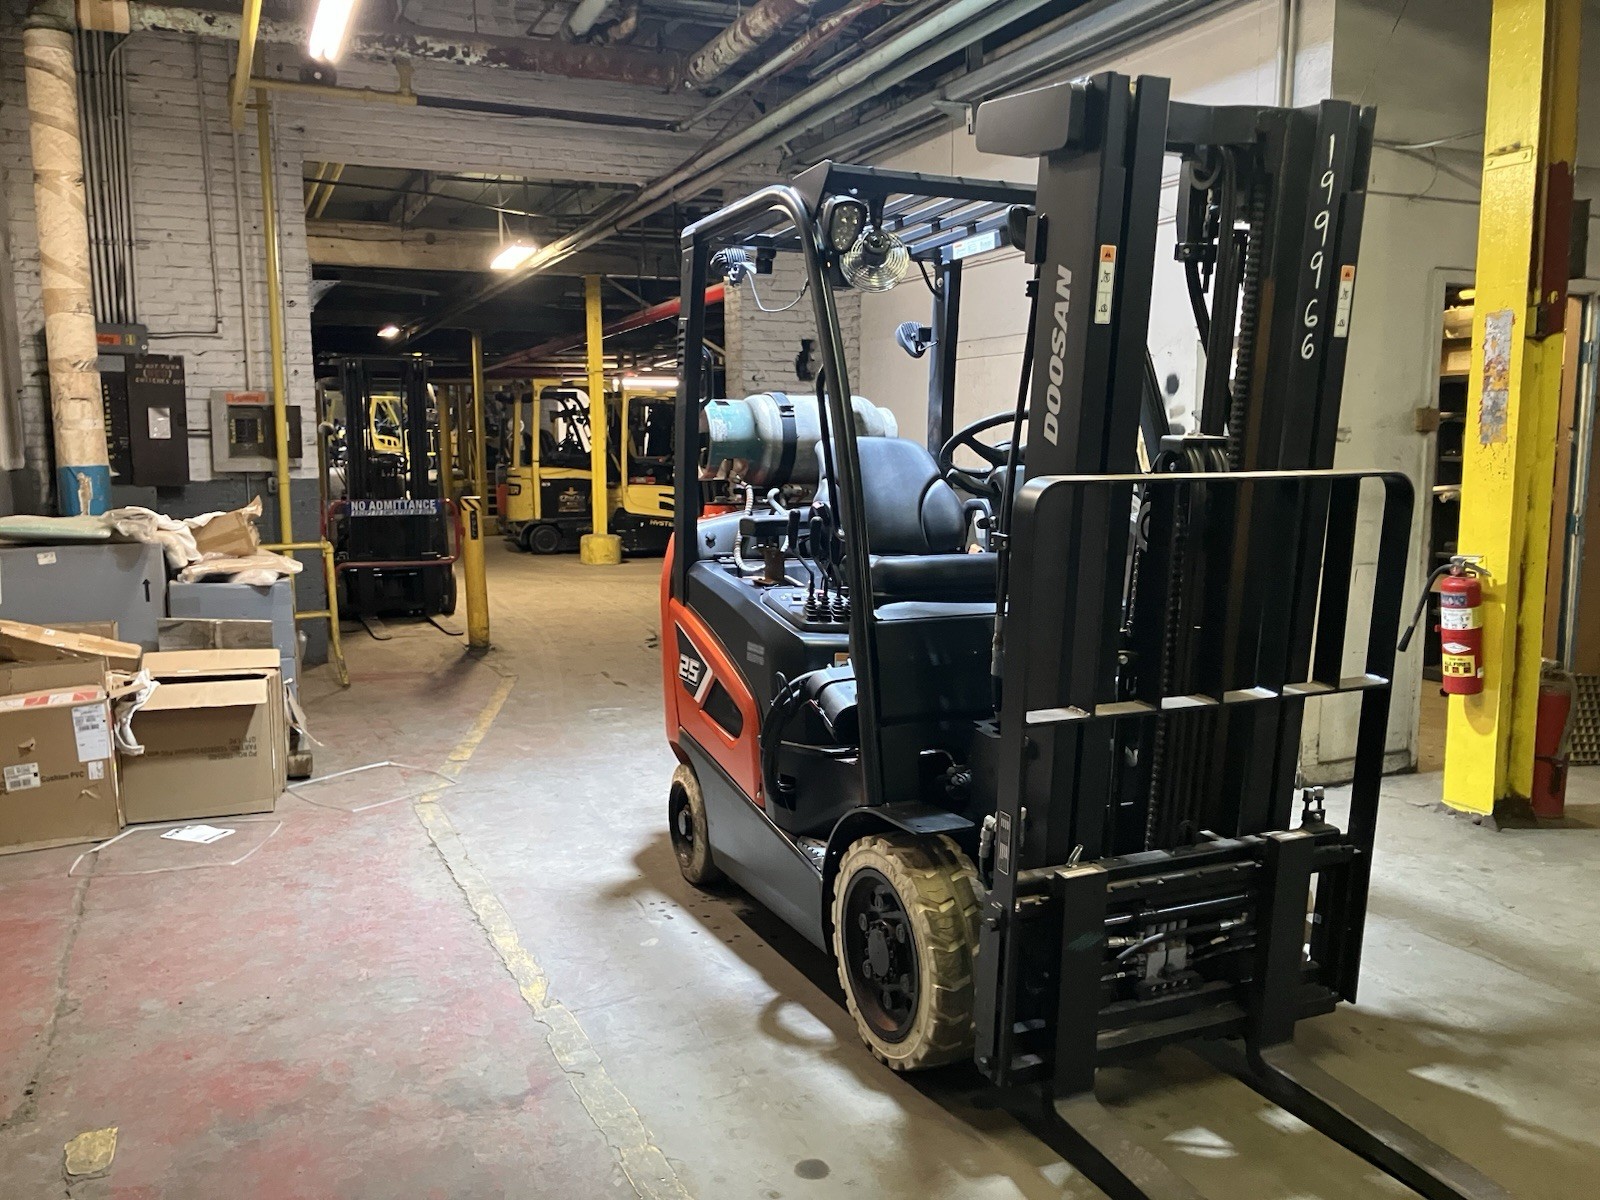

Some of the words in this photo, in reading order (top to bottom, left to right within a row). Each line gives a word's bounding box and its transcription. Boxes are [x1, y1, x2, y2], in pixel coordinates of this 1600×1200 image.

[1300, 133, 1336, 360] 199966
[1043, 264, 1072, 446] DOOSAN
[351, 501, 366, 511] NO
[369, 500, 435, 510] ADMITTANCE
[679, 653, 701, 687] 25
[70, 770, 85, 778] PVC
